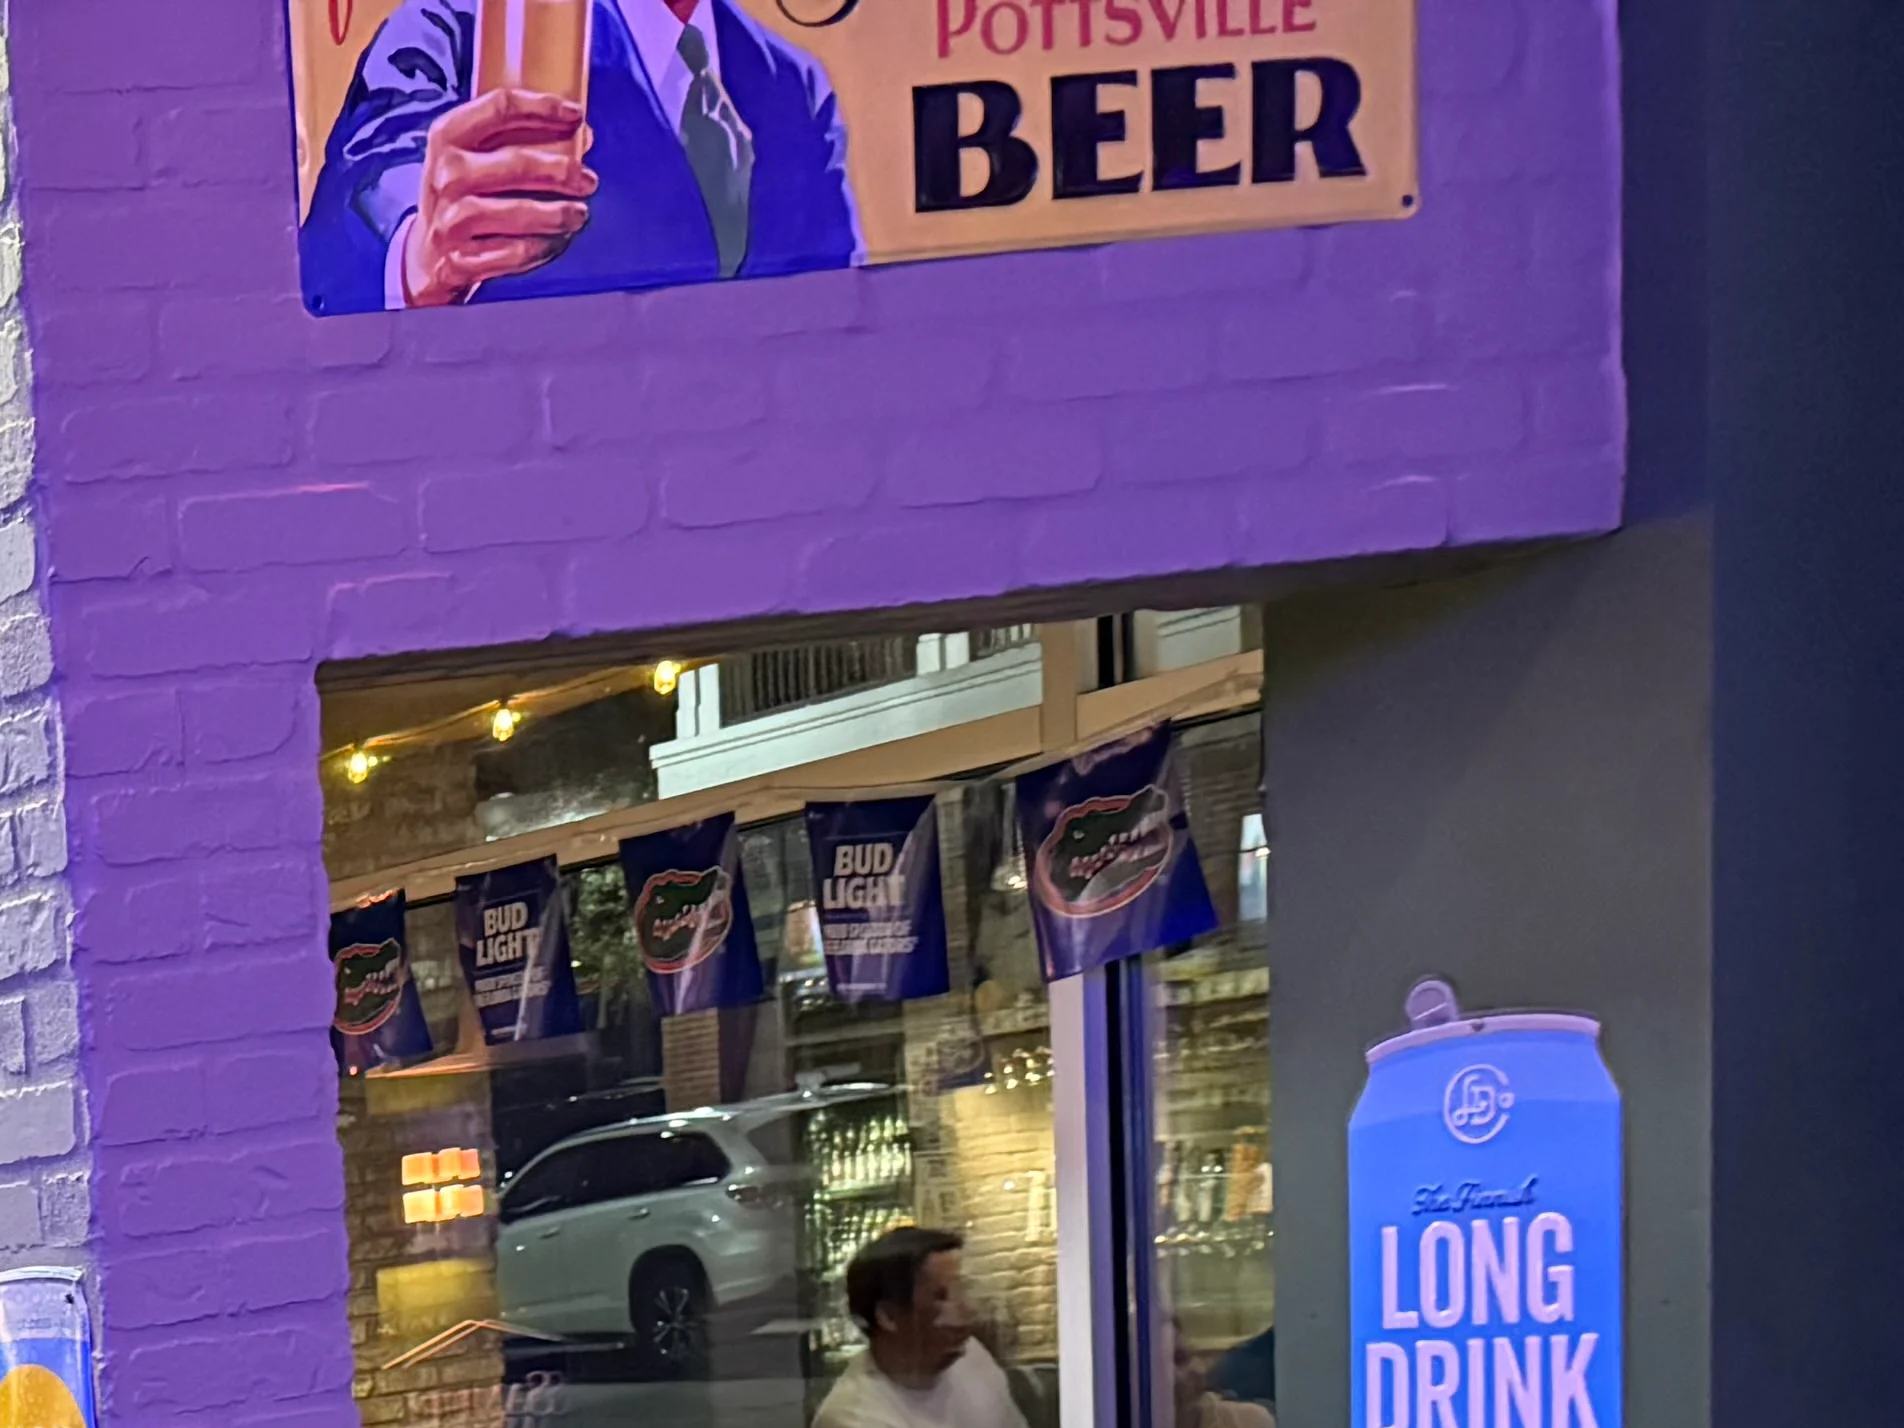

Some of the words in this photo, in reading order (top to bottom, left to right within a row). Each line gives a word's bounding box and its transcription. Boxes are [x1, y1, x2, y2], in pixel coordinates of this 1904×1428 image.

[912, 56, 1368, 213] BEER
[834, 842, 894, 877] BUD
[823, 874, 905, 910] LIGHT
[483, 901, 528, 937] BUD
[476, 927, 541, 967] LIGHT
[1380, 1212, 1574, 1330] LONG
